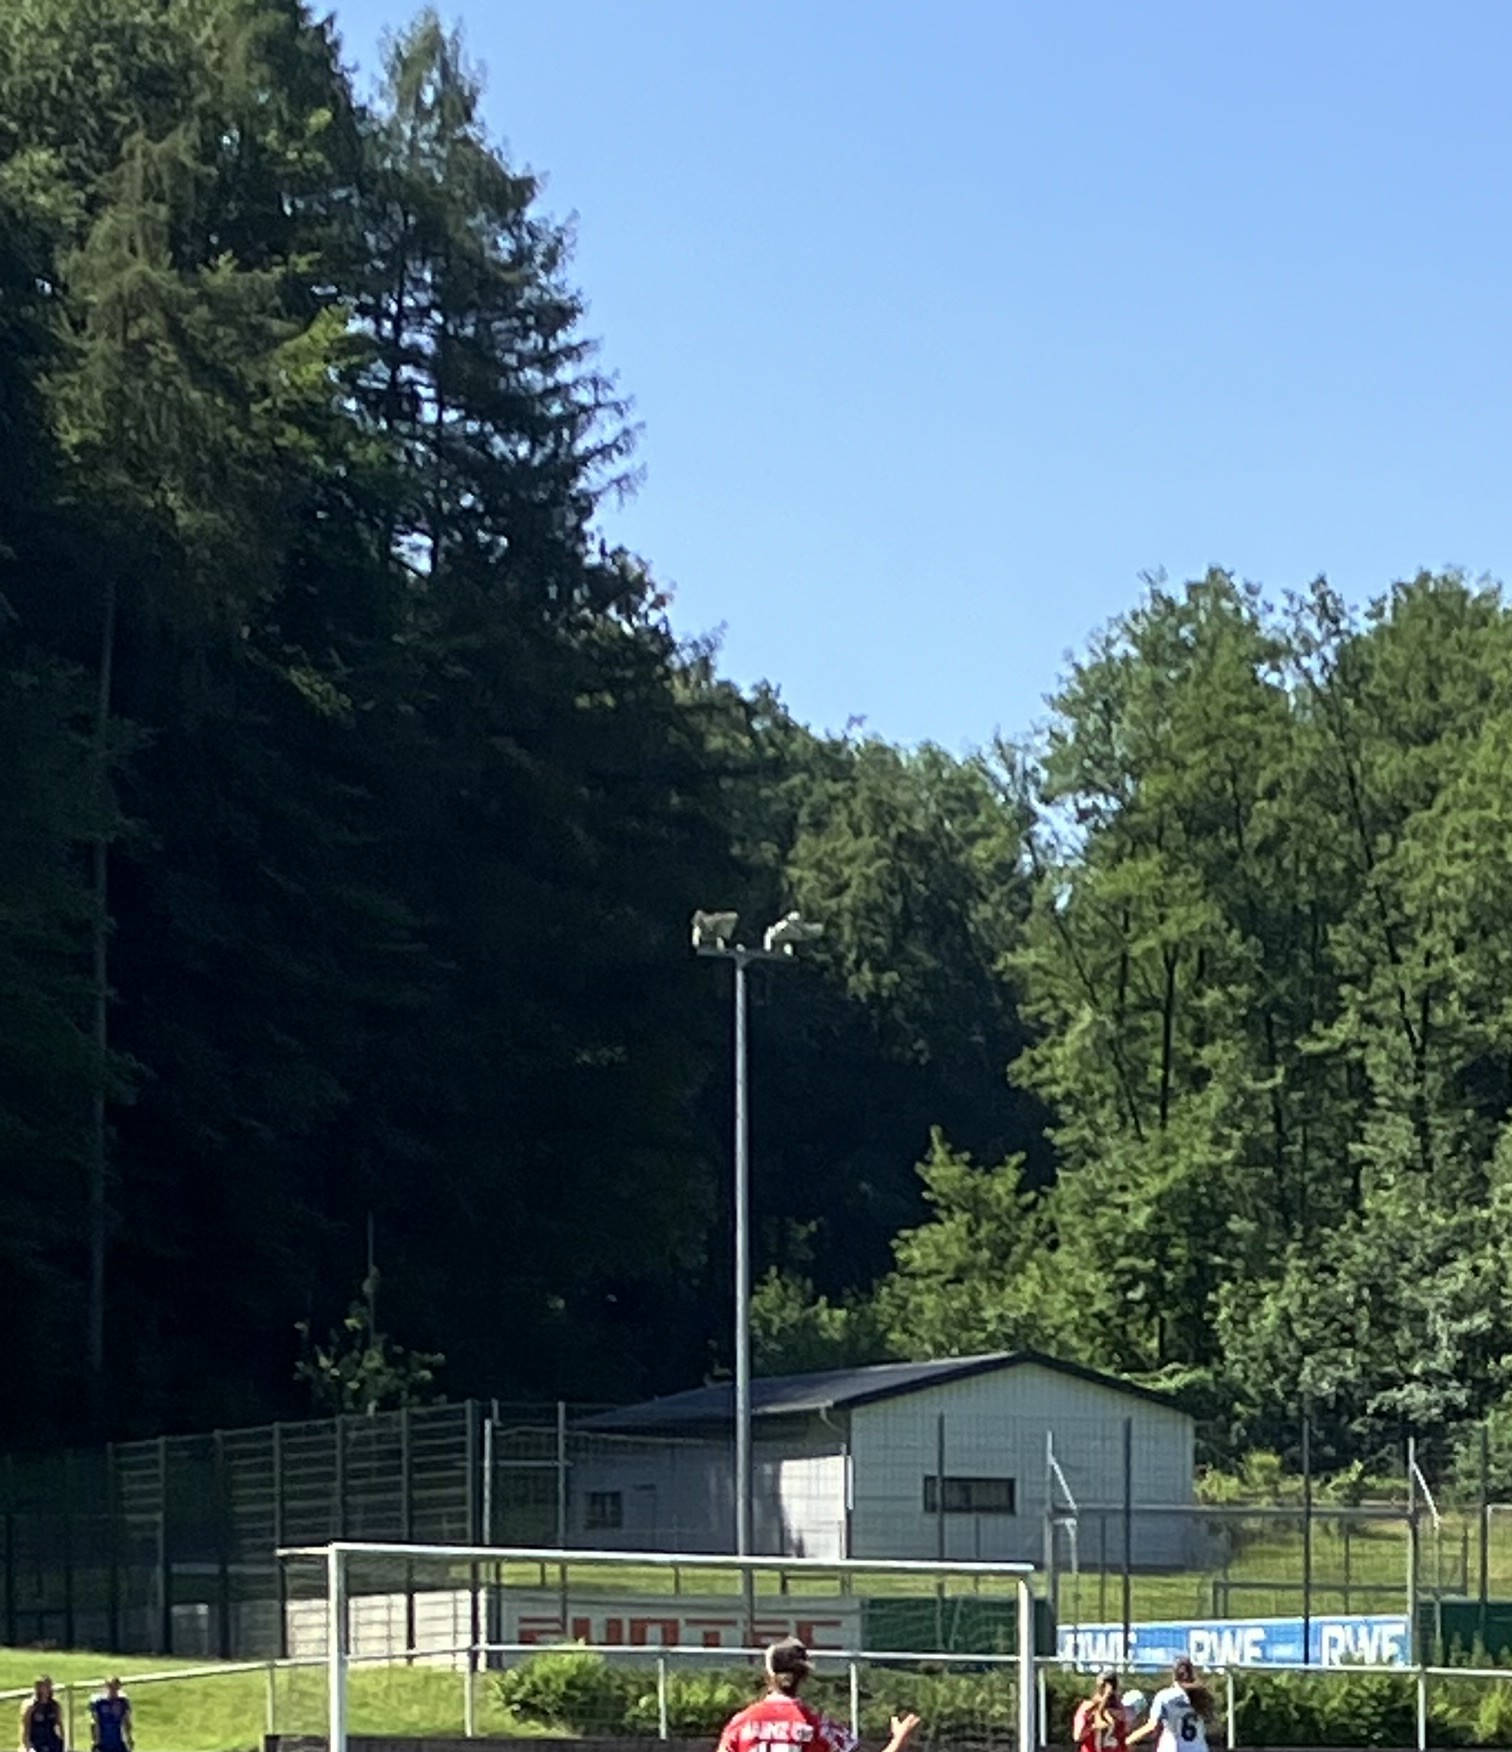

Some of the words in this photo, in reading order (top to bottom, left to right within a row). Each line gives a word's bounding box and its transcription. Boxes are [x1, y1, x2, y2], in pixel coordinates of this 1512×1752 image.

[1189, 1627, 1265, 1673] RWE
[1321, 1624, 1406, 1667] RWE
[1181, 1712, 1198, 1742] 6
